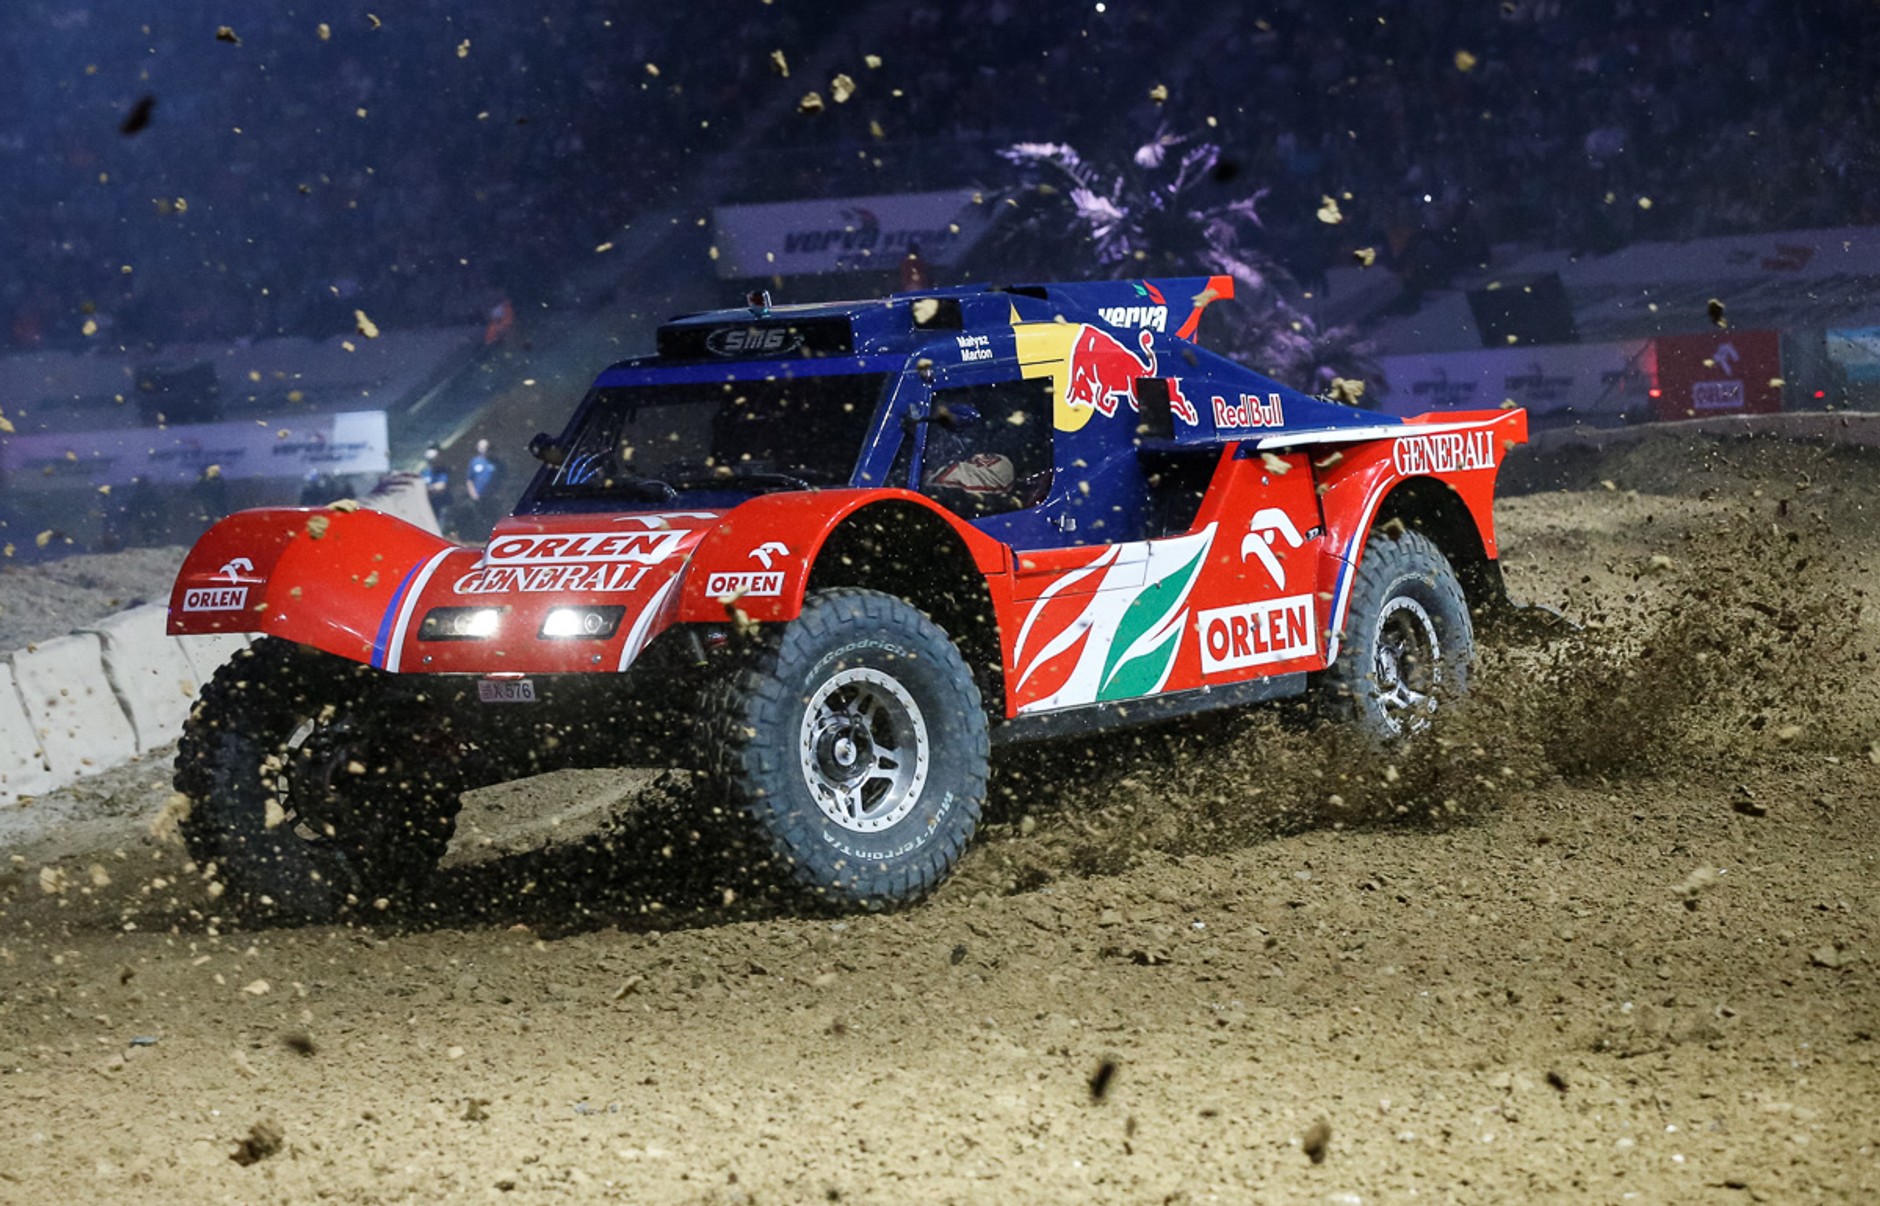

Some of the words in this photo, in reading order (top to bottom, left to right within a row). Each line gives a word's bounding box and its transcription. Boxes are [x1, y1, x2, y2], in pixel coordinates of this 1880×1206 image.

[1099, 305, 1168, 332] verva
[725, 328, 786, 350] SMG
[960, 348, 993, 362] Marton
[1393, 431, 1495, 475] GENERALI
[490, 535, 672, 559] ORLEN
[453, 563, 653, 594] GENERALI
[187, 590, 243, 608] ORLEN
[1207, 605, 1309, 662] ORLEN
